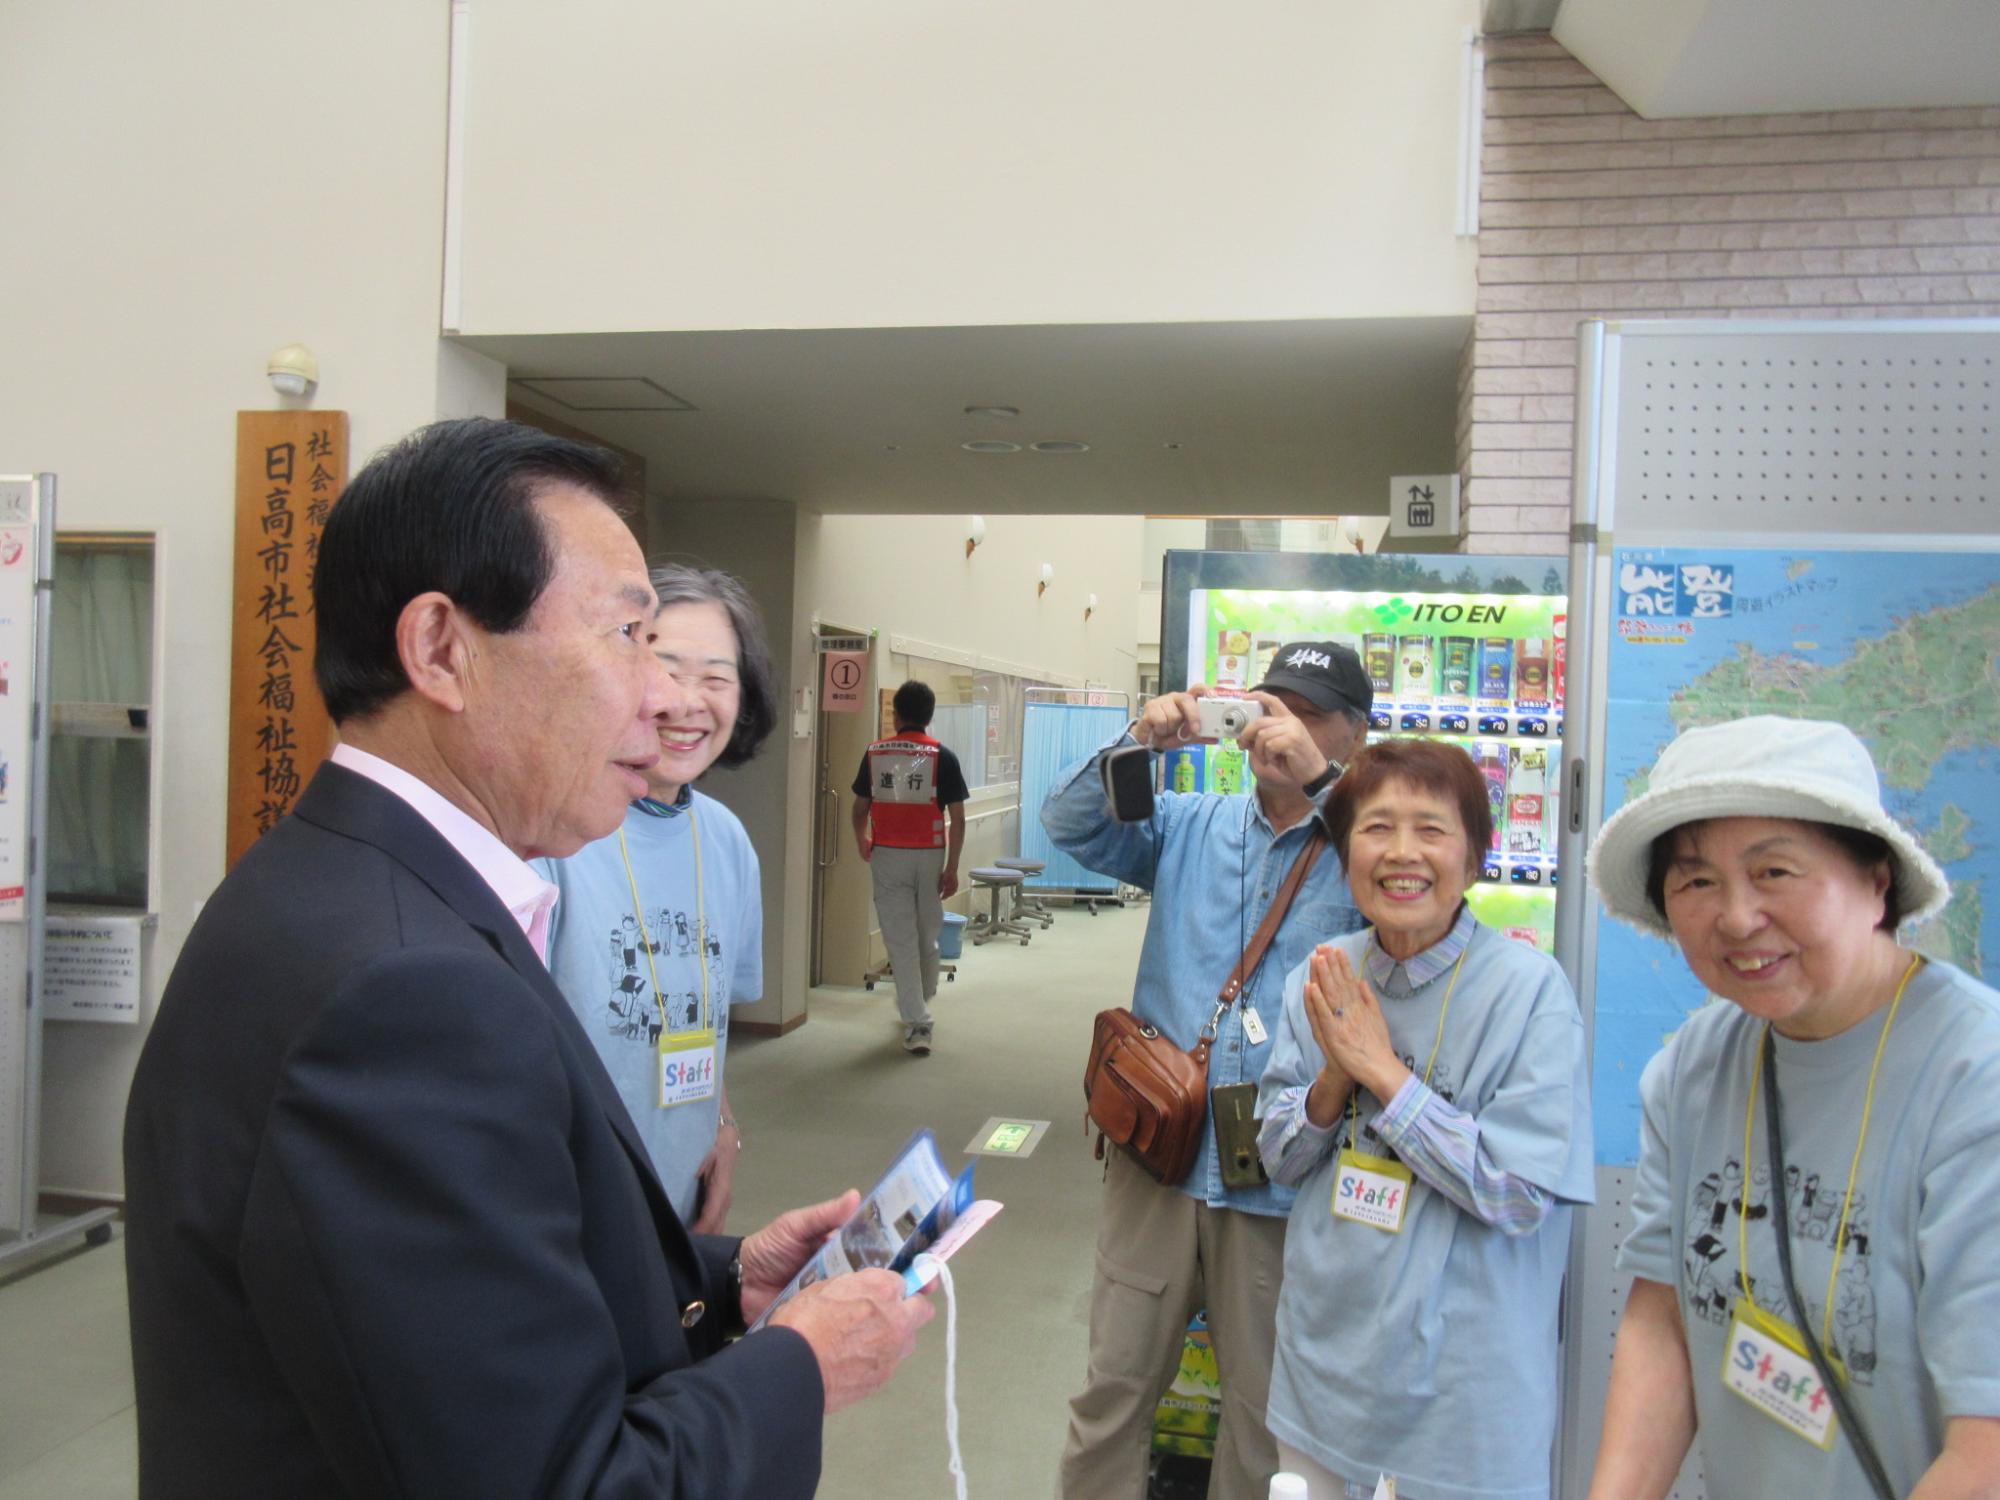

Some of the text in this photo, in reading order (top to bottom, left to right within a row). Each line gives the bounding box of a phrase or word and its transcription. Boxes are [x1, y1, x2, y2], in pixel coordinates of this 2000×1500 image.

[305, 430, 335, 616] 社会福
[1412, 604, 1507, 624] ITO EN
[665, 1057, 712, 1087] Staff
[1340, 1176, 1400, 1210] Staff
[1734, 1340, 1825, 1414] Staff
